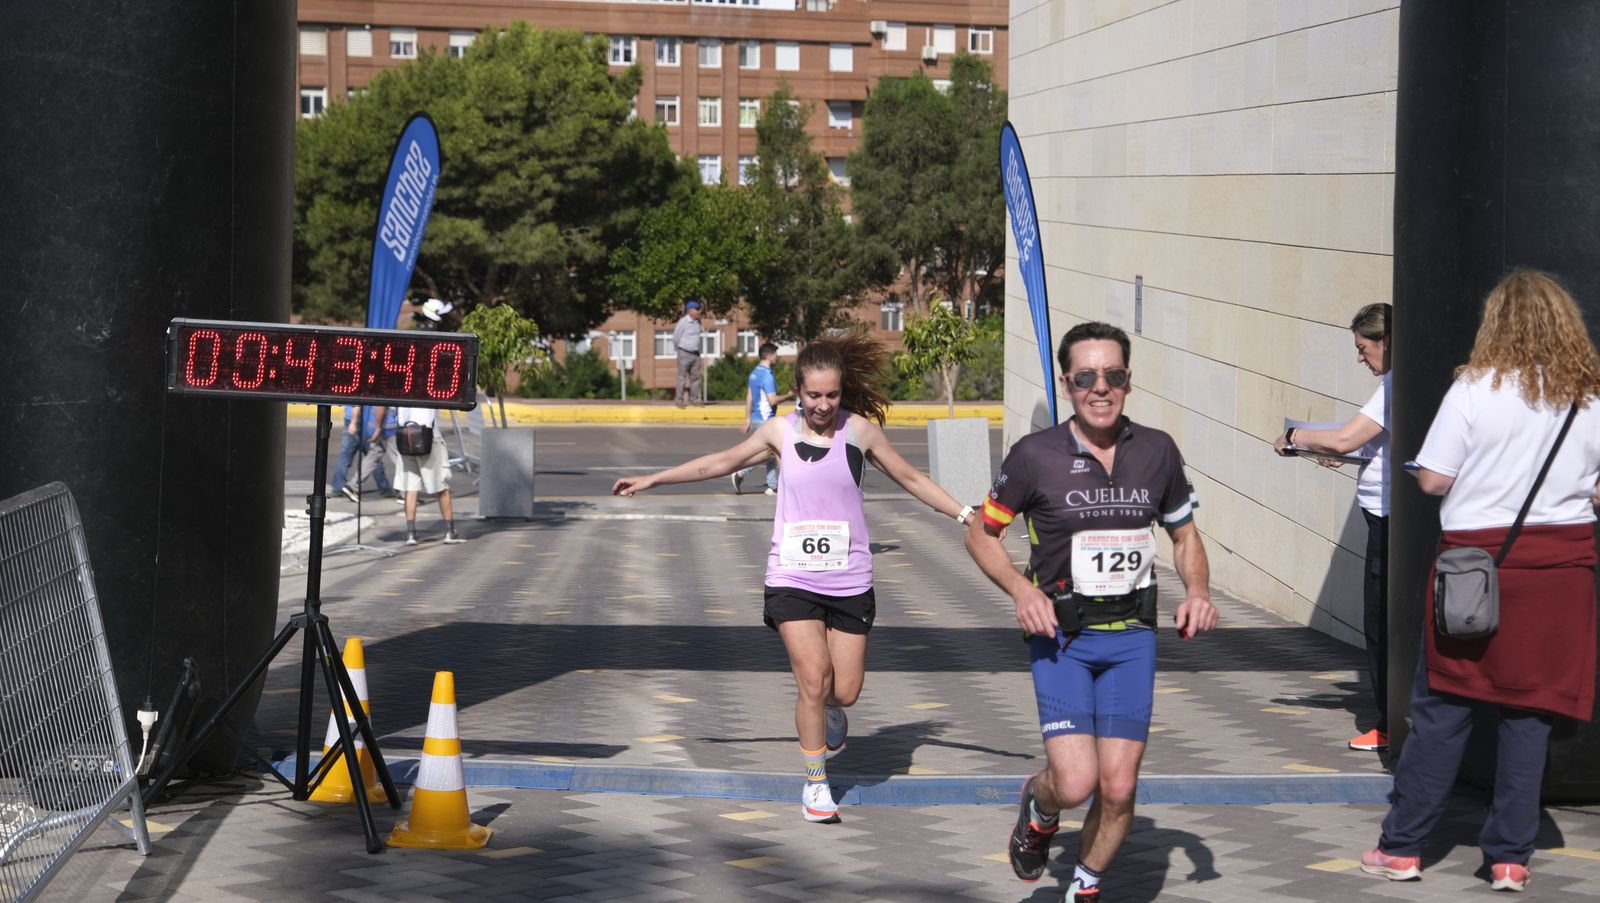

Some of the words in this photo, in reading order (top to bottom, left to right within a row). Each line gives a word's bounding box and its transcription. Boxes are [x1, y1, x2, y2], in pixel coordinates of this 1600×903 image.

[185, 329, 463, 399] 00:43:40
[1065, 487, 1150, 507] CUELLAR
[1079, 510, 1114, 519] STONE
[1120, 509, 1143, 517] 1958
[802, 537, 831, 555] 66
[1091, 550, 1142, 573] 129
